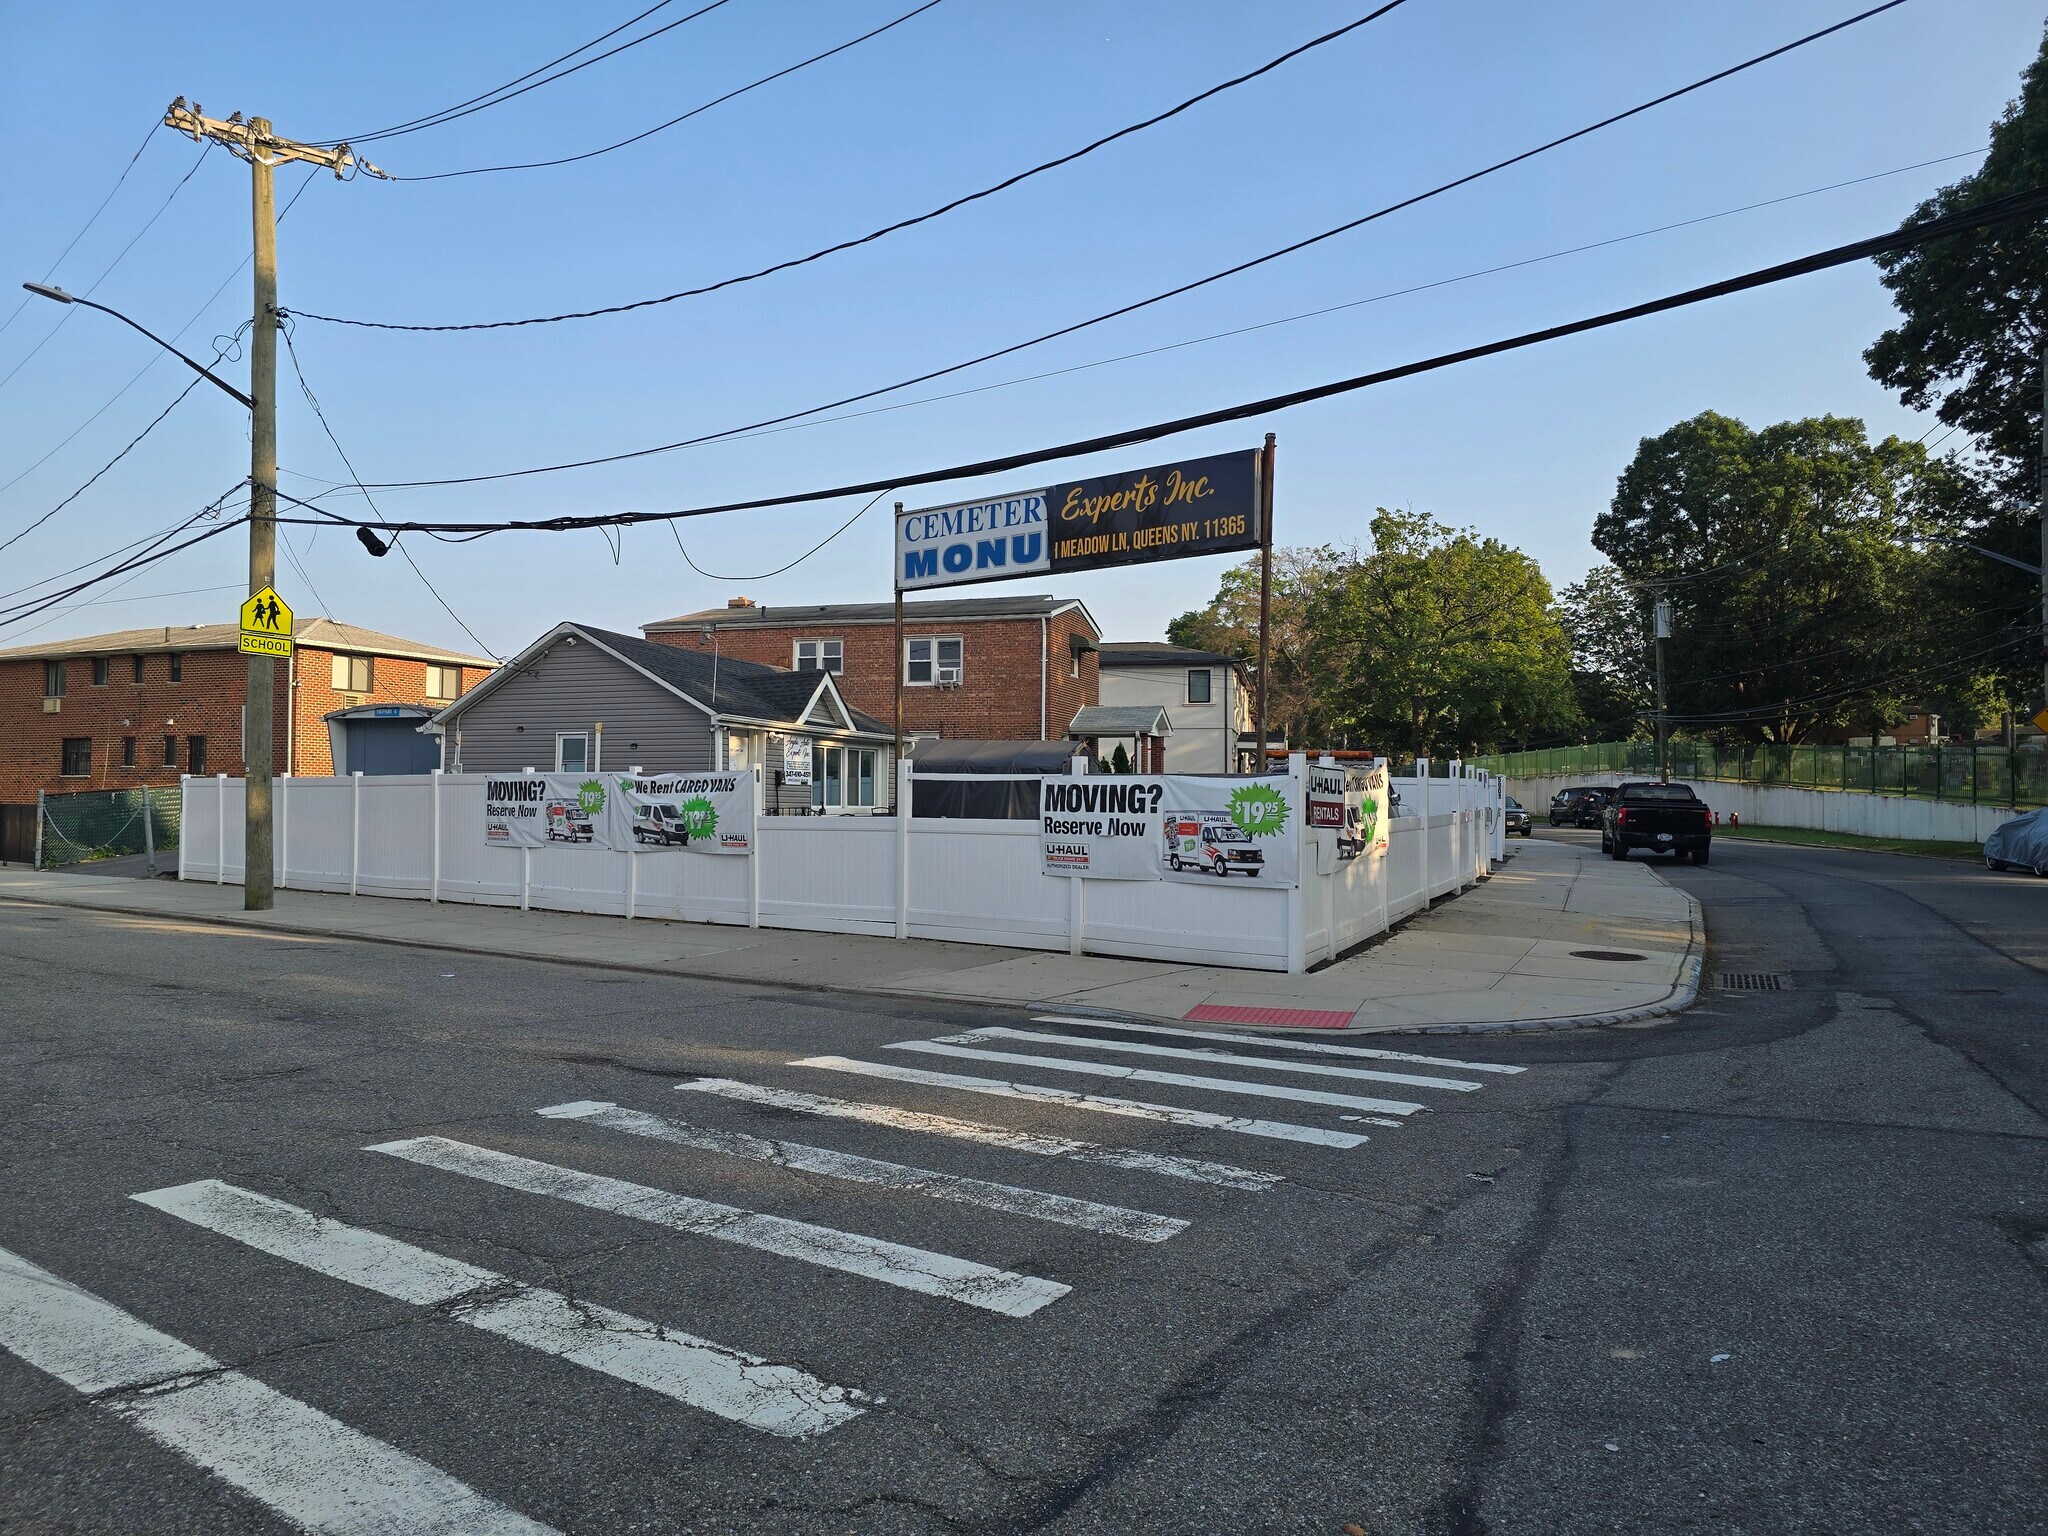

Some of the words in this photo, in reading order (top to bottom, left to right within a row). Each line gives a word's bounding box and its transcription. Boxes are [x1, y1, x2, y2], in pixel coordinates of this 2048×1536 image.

[1061, 474, 1159, 524] Experts
[1164, 470, 1215, 506] Inc.
[1061, 535, 1110, 559] MEADOW
[1112, 532, 1131, 553] LN,
[1133, 525, 1179, 550] QUEENS
[1181, 522, 1200, 542] NY.
[1204, 514, 1246, 539] 11365
[904, 530, 1050, 580] MONU
[243, 638, 289, 652] SCHOOL
[487, 780, 546, 802] MOVING?
[634, 780, 648, 794] We
[650, 780, 674, 794] Rent
[674, 779, 709, 794] CARGO
[709, 777, 737, 793] VANS
[1311, 775, 1343, 795] U-HAUL
[1044, 783, 1164, 814] MOVING?
[487, 804, 516, 817] Reserve
[518, 805, 537, 817] Now
[1313, 806, 1340, 821] RENTALS
[488, 823, 508, 831] U-HAUL
[1044, 816, 1102, 837] Reserve
[1108, 818, 1146, 837] Now
[1047, 844, 1088, 856] U-HAUL
